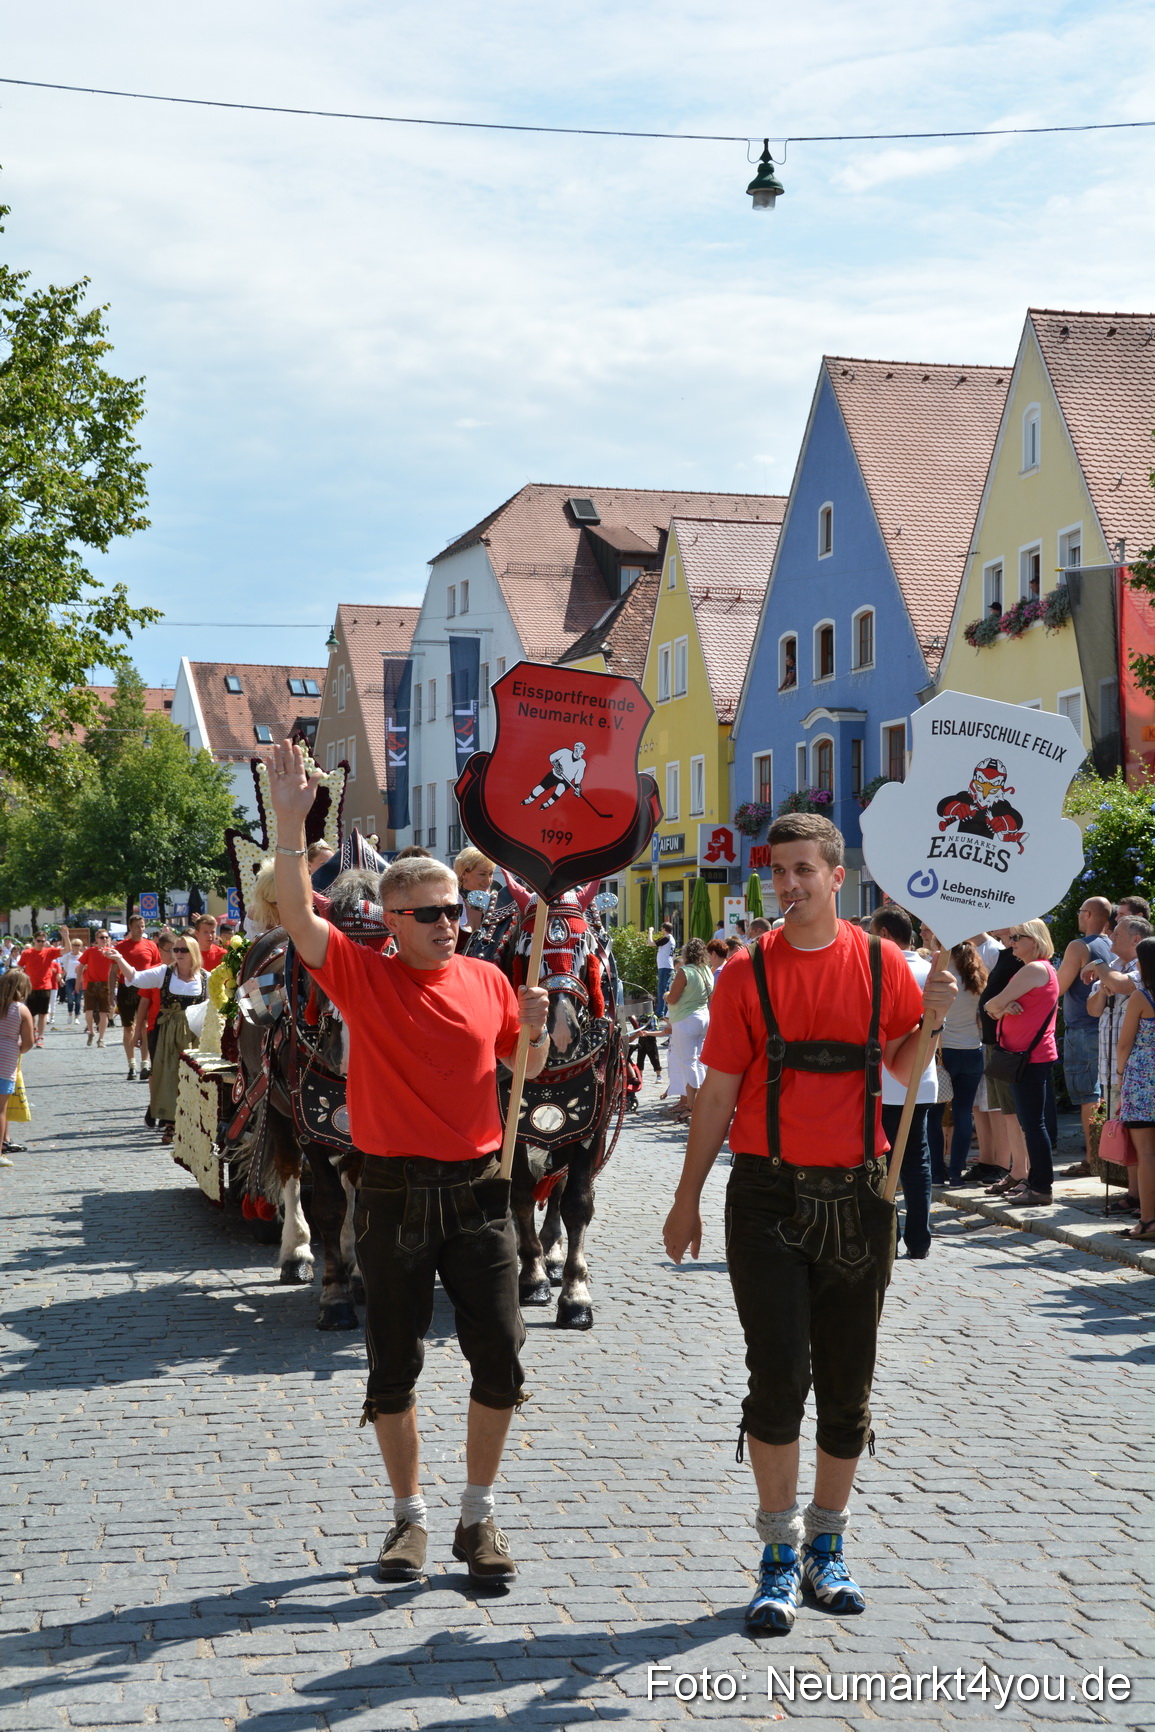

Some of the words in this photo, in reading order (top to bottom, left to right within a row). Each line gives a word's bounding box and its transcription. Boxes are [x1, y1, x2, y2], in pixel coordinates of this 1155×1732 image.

[512, 681, 635, 713] Eissportfreunde
[518, 702, 594, 727] Neumarkt
[931, 719, 1032, 749] EISLAUFSCHULE
[1031, 737, 1068, 764] FELIX
[540, 829, 573, 846] 1999
[652, 836, 658, 859] P
[948, 835, 997, 851] NEUMARKT
[927, 836, 1011, 873] EAGLES
[940, 893, 976, 907] Neumarkt
[977, 900, 991, 910] e.V.
[942, 879, 1016, 905] Lebenshilfe
[141, 910, 157, 918] TAXI
